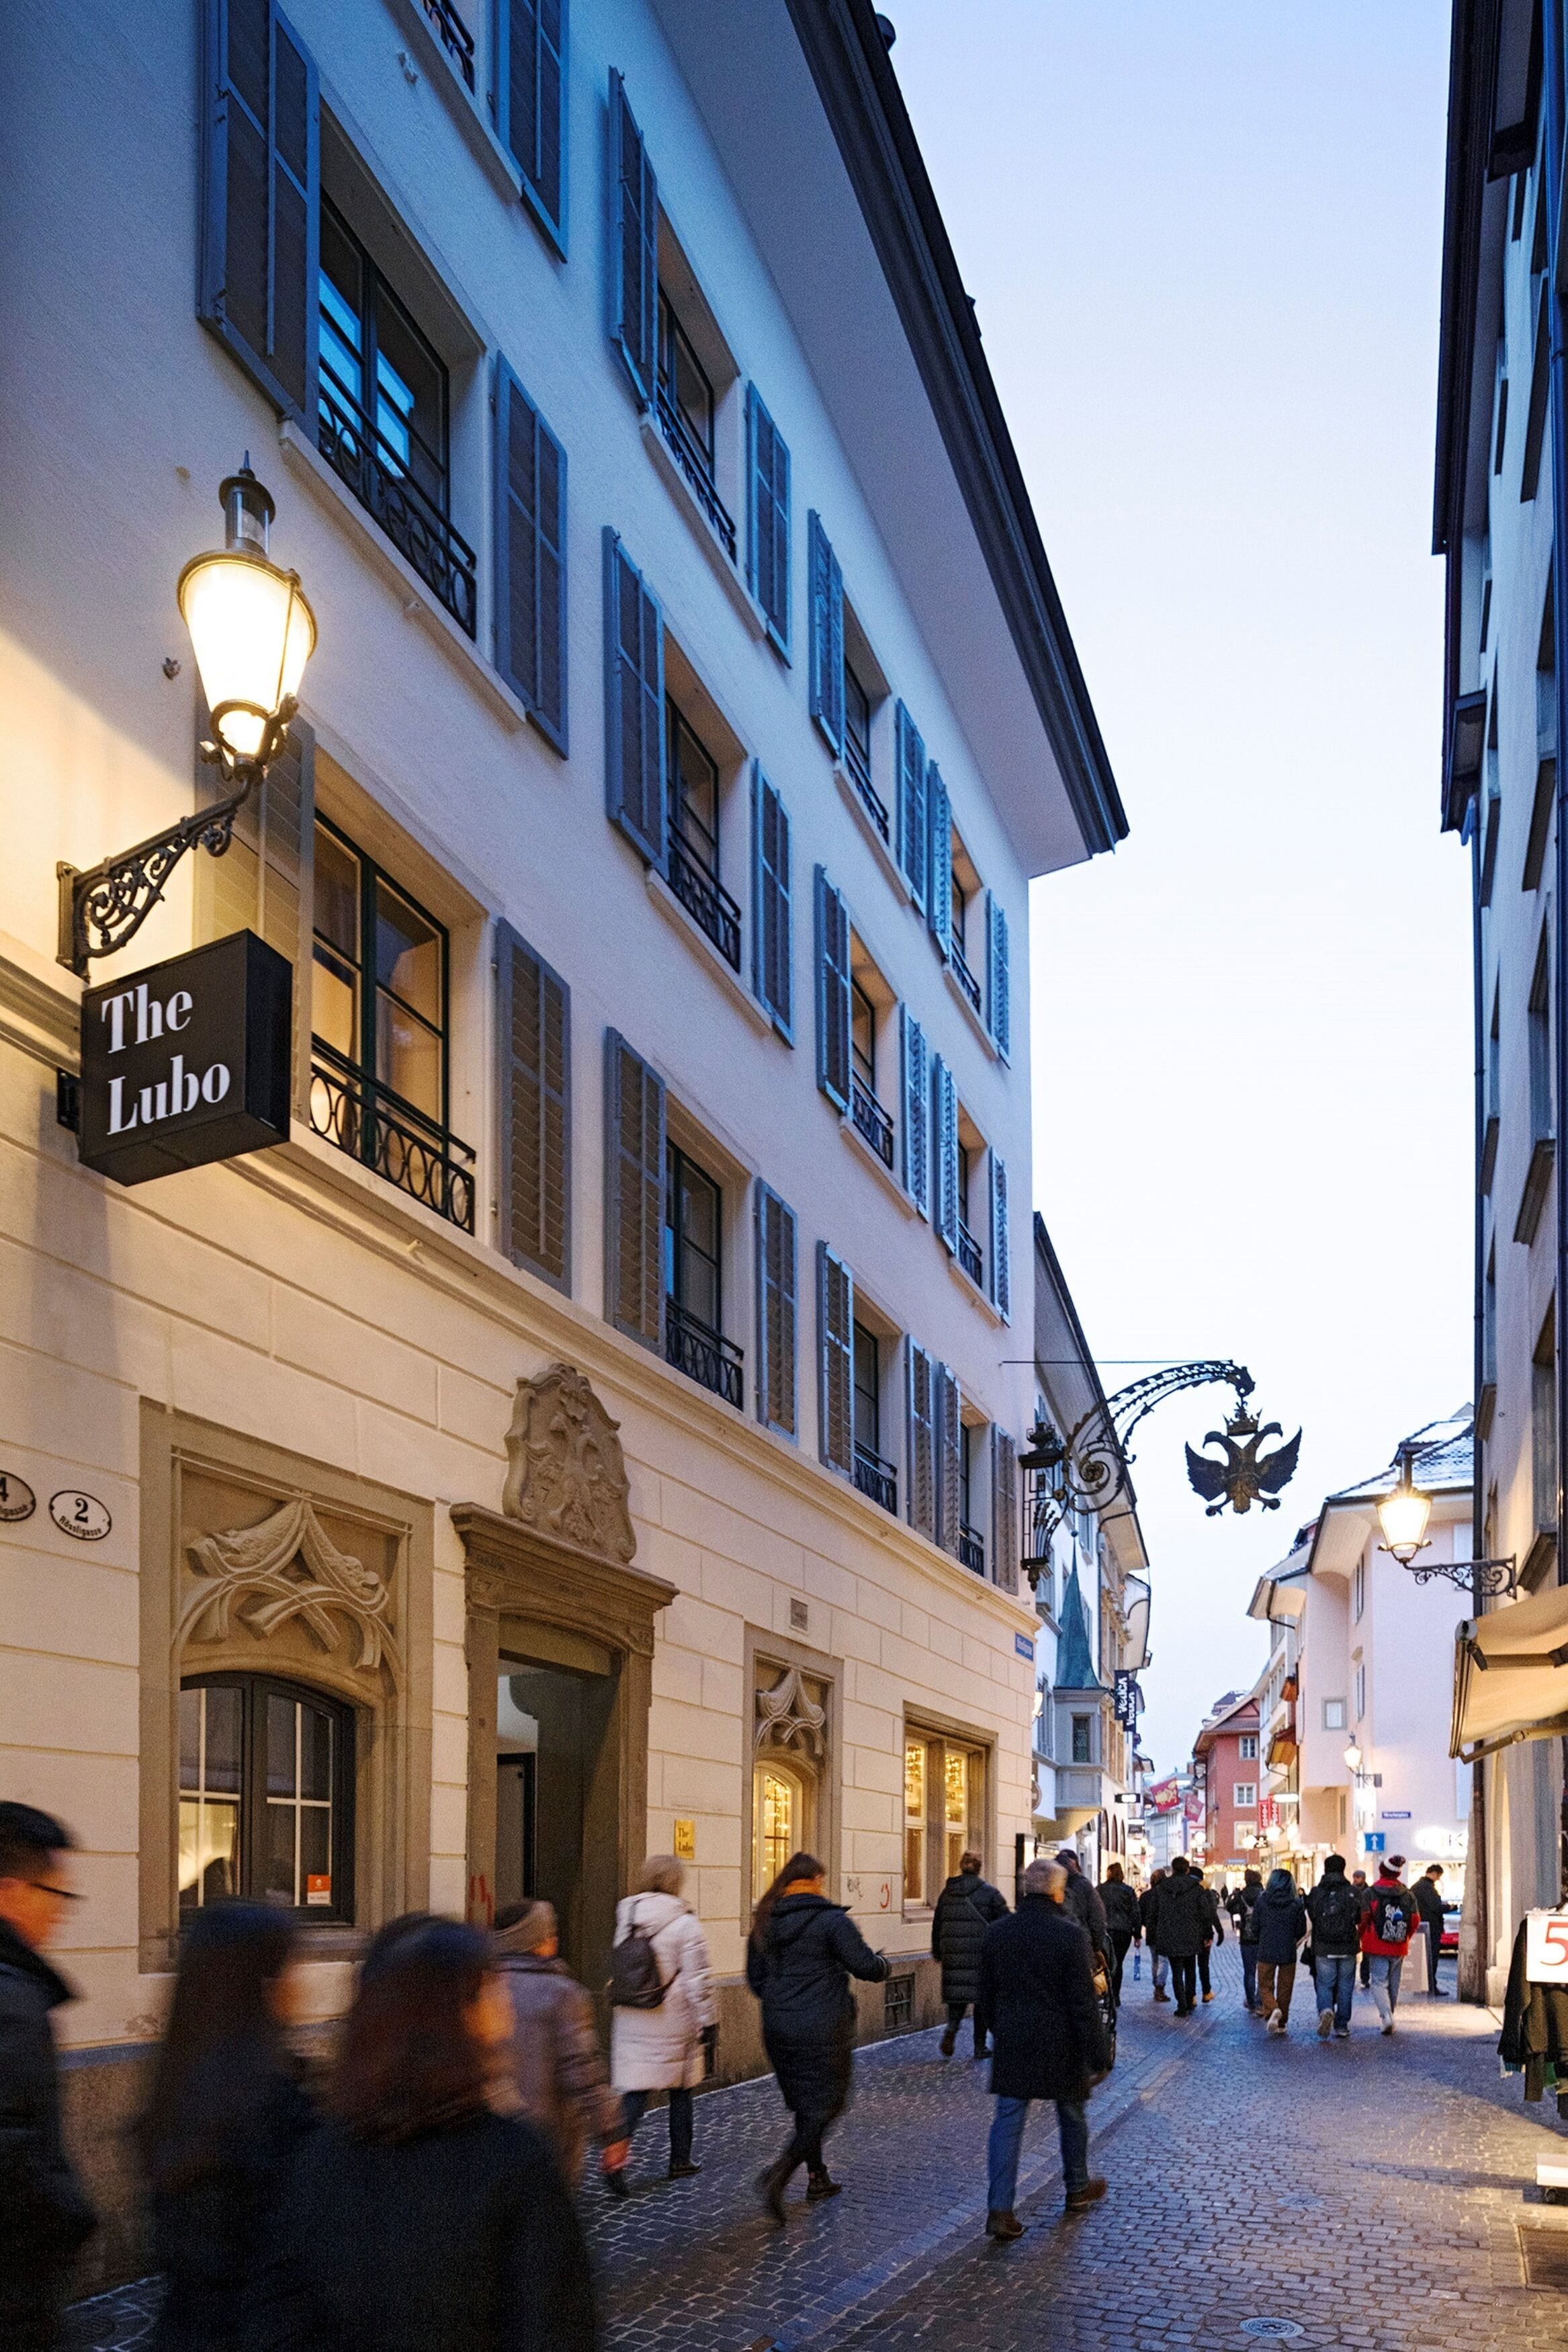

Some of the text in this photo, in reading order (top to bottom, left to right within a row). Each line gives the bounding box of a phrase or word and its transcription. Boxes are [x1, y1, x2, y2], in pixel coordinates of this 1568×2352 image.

[101, 983, 193, 1054] The
[107, 1054, 230, 1135] Lubo
[59, 1515, 102, 1538] Rössligasse
[75, 1497, 89, 1523] 2
[678, 1827, 689, 1838] The
[1540, 1921, 1568, 1966] 5
